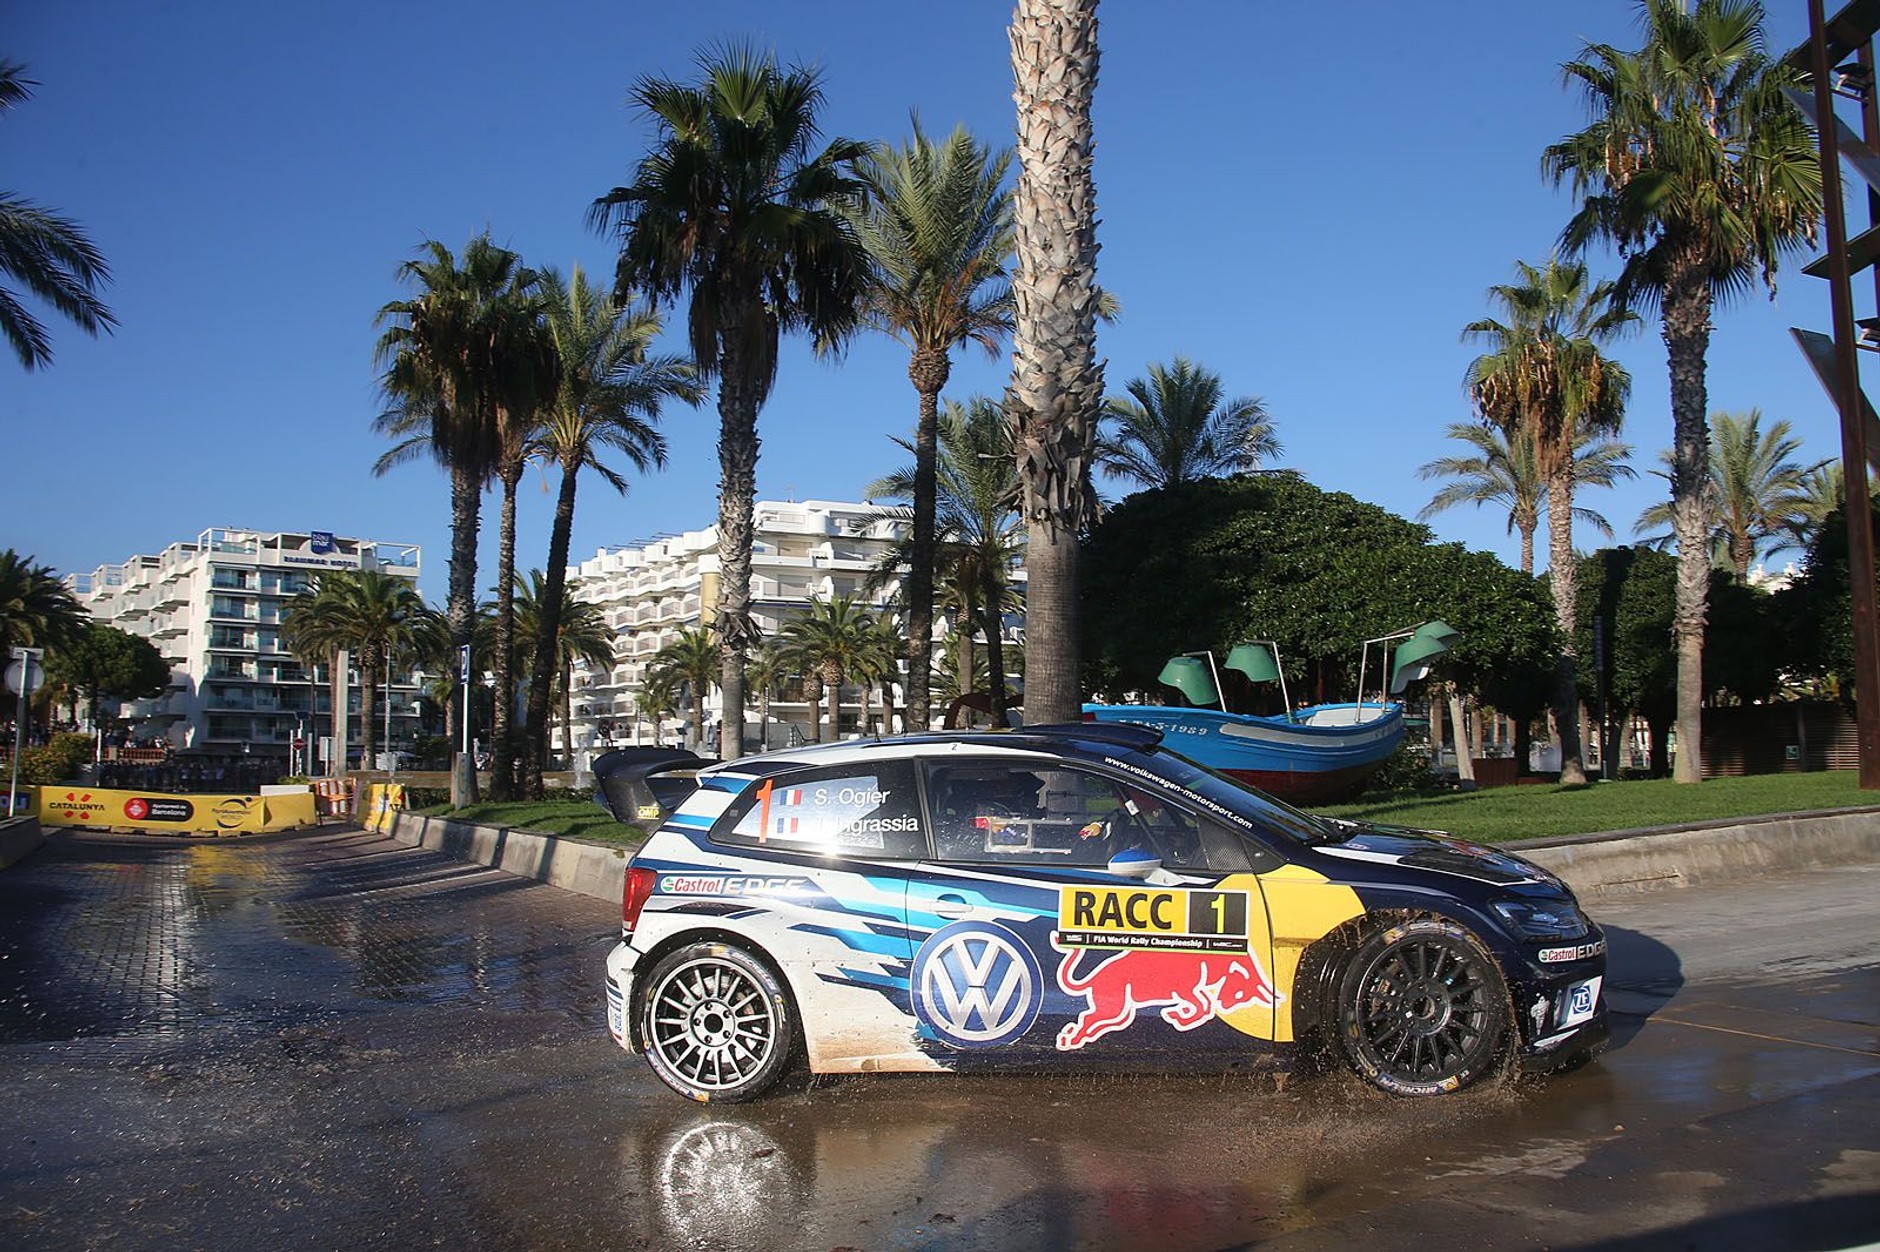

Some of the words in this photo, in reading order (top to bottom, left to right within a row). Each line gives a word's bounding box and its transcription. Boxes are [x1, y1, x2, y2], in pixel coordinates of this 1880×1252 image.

[815, 788, 831, 805] S.
[839, 788, 890, 808] Ogier
[1104, 756, 1253, 830] www.volkswagen-motorsport.com
[49, 802, 105, 811] CATALUNYA
[151, 809, 187, 817] Barcelona
[756, 779, 773, 843] 1
[674, 877, 721, 894] Castrol
[1074, 891, 1173, 929] RACC
[1211, 894, 1225, 933] 1
[1108, 935, 1129, 945] World
[1131, 937, 1149, 947] Rally
[1150, 937, 1203, 949] Championship
[1548, 948, 1575, 960] Castrol
[1574, 992, 1589, 1008] ZF
